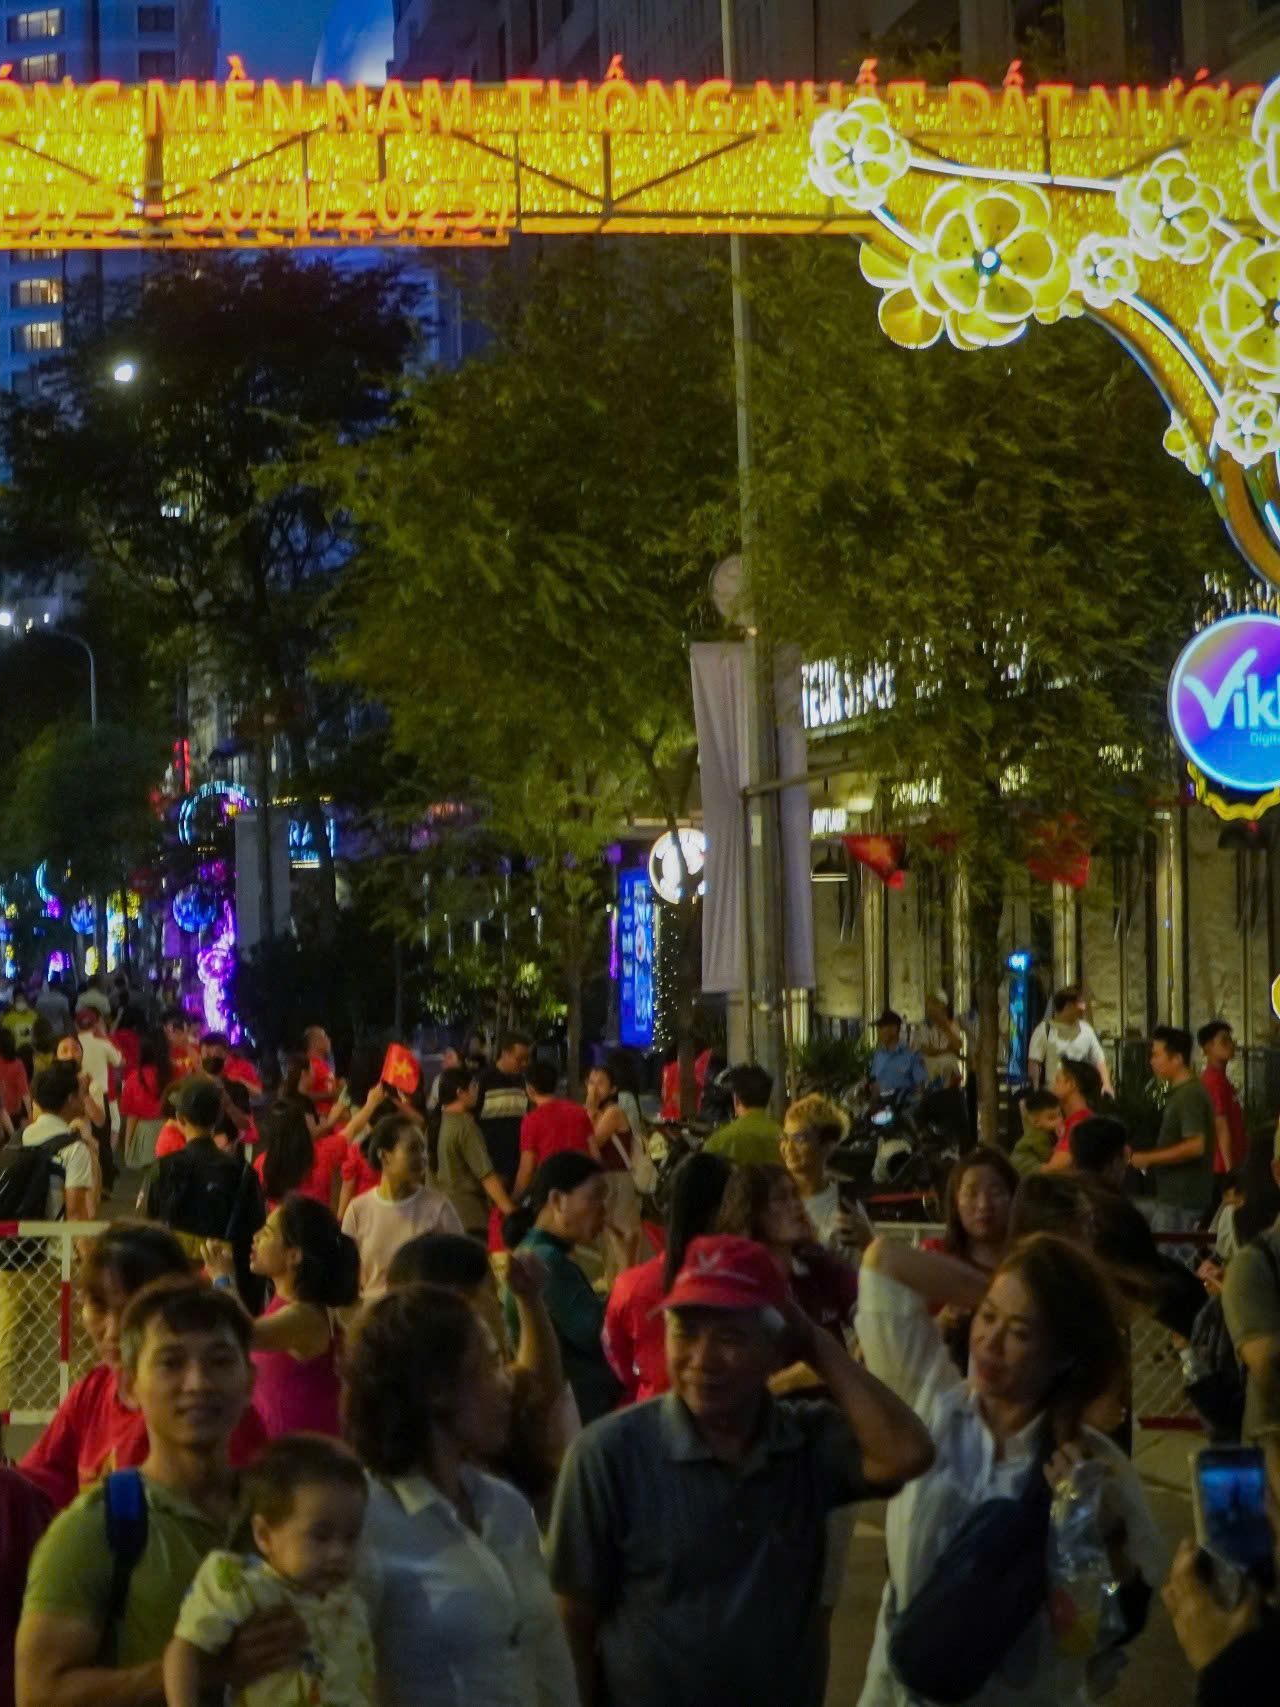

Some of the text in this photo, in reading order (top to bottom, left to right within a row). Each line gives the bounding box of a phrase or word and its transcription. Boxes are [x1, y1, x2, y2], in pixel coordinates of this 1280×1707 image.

[145, 54, 304, 136] MIỀN
[324, 78, 474, 135] NAM
[505, 54, 733, 135] THỐNG
